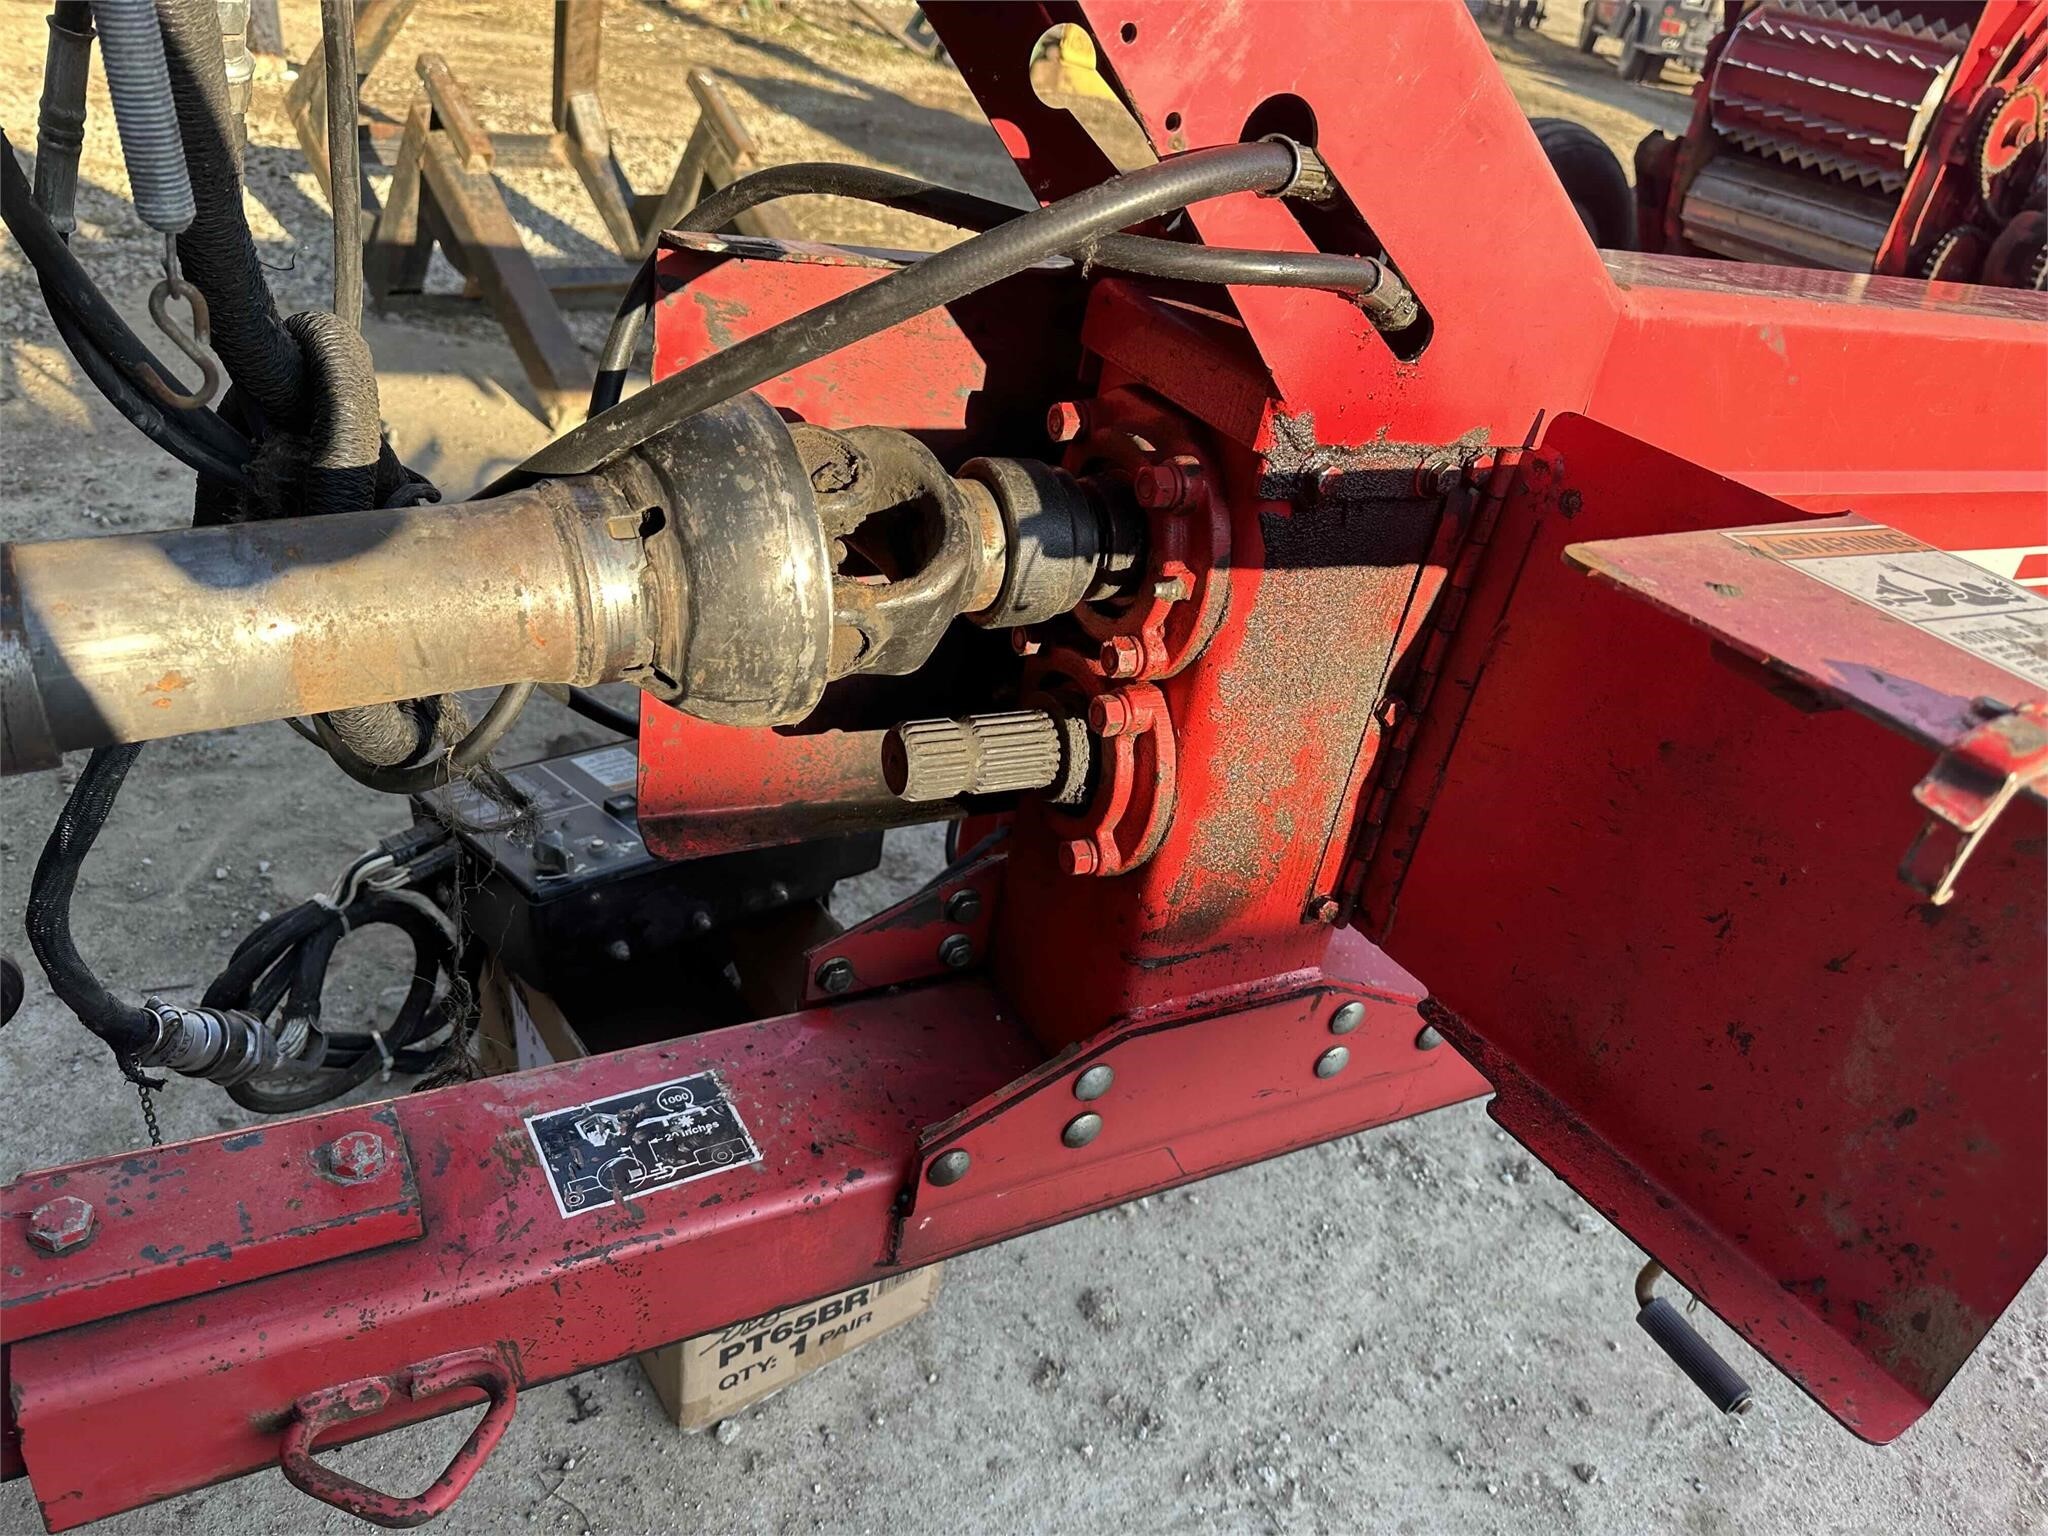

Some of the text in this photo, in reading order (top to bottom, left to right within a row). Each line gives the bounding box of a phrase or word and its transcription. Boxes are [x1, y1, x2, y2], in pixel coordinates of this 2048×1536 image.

[1781, 533, 1919, 553] WARNING
[661, 1092, 689, 1105] 1000
[679, 1121, 720, 1137] inches
[718, 1287, 869, 1369] PT65BR
[718, 1355, 777, 1391] QTY:
[788, 1333, 808, 1357] 1
[818, 1311, 873, 1346] PAIR
